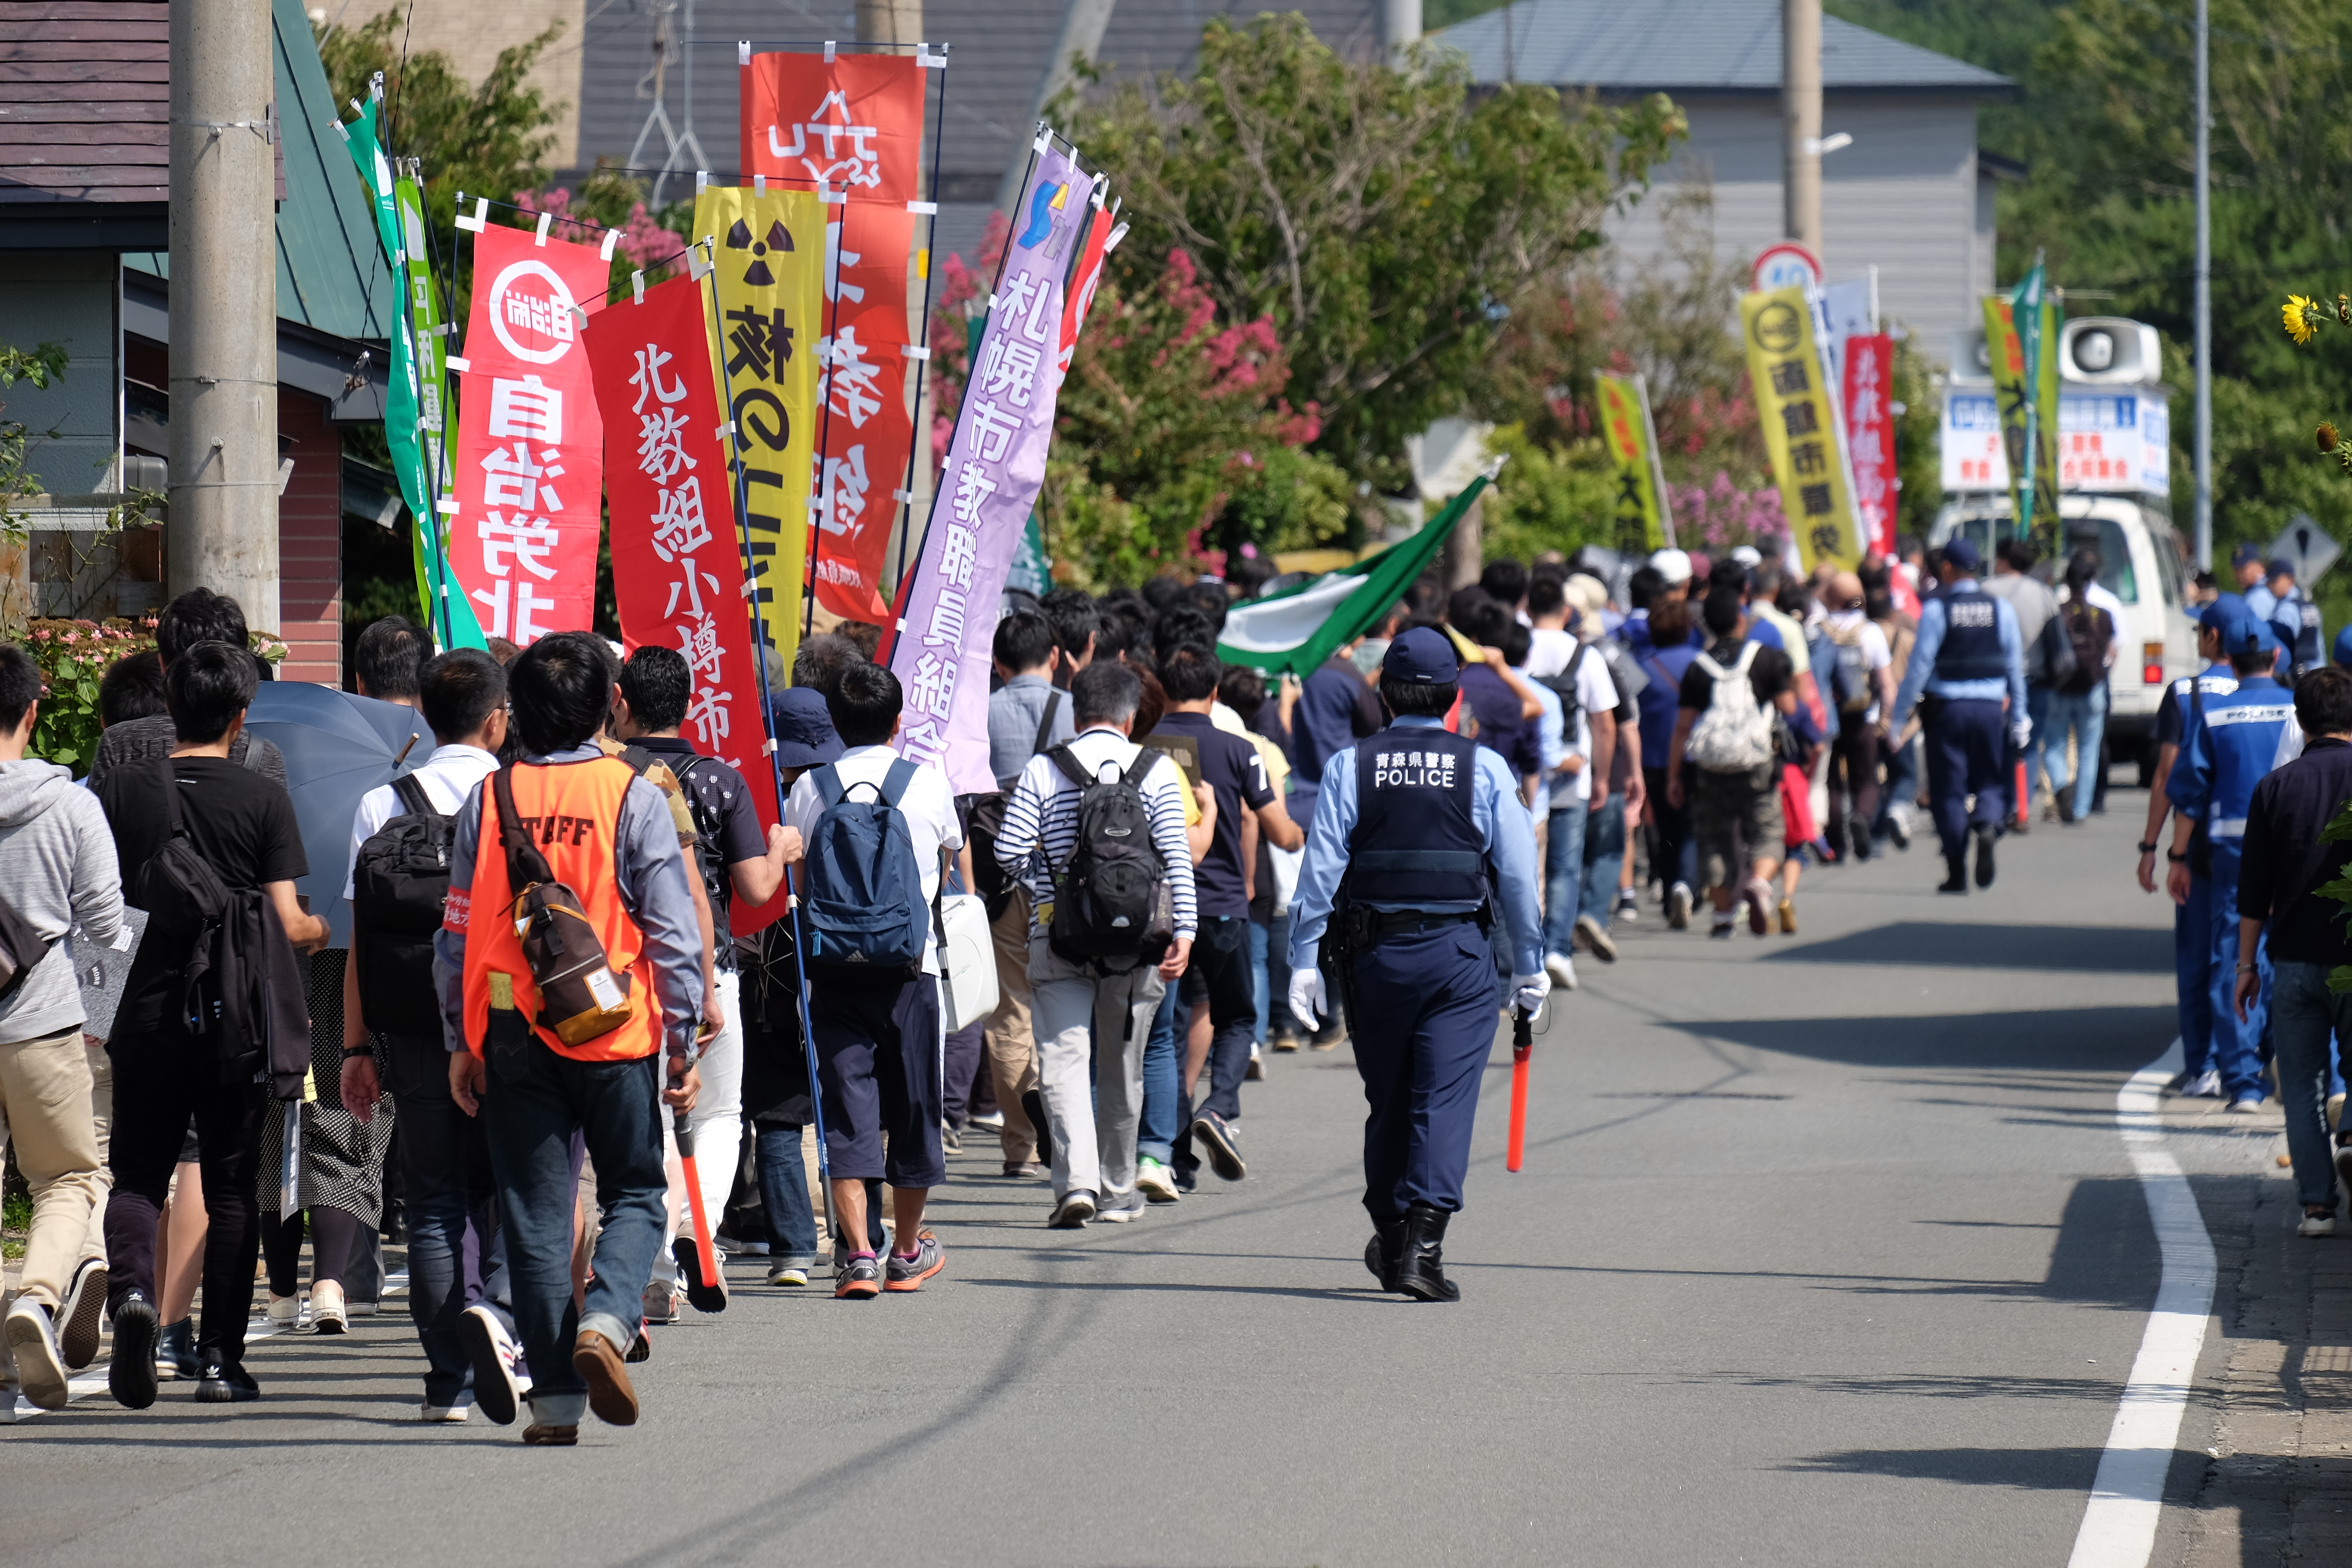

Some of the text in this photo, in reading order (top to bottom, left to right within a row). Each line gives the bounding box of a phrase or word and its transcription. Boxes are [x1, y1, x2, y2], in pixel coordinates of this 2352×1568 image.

[628, 343, 741, 770] 北教組小樽市
[1375, 752, 1456, 770] 青森県警察
[1375, 769, 1455, 788] POLICE
[499, 816, 594, 847] TAFF
